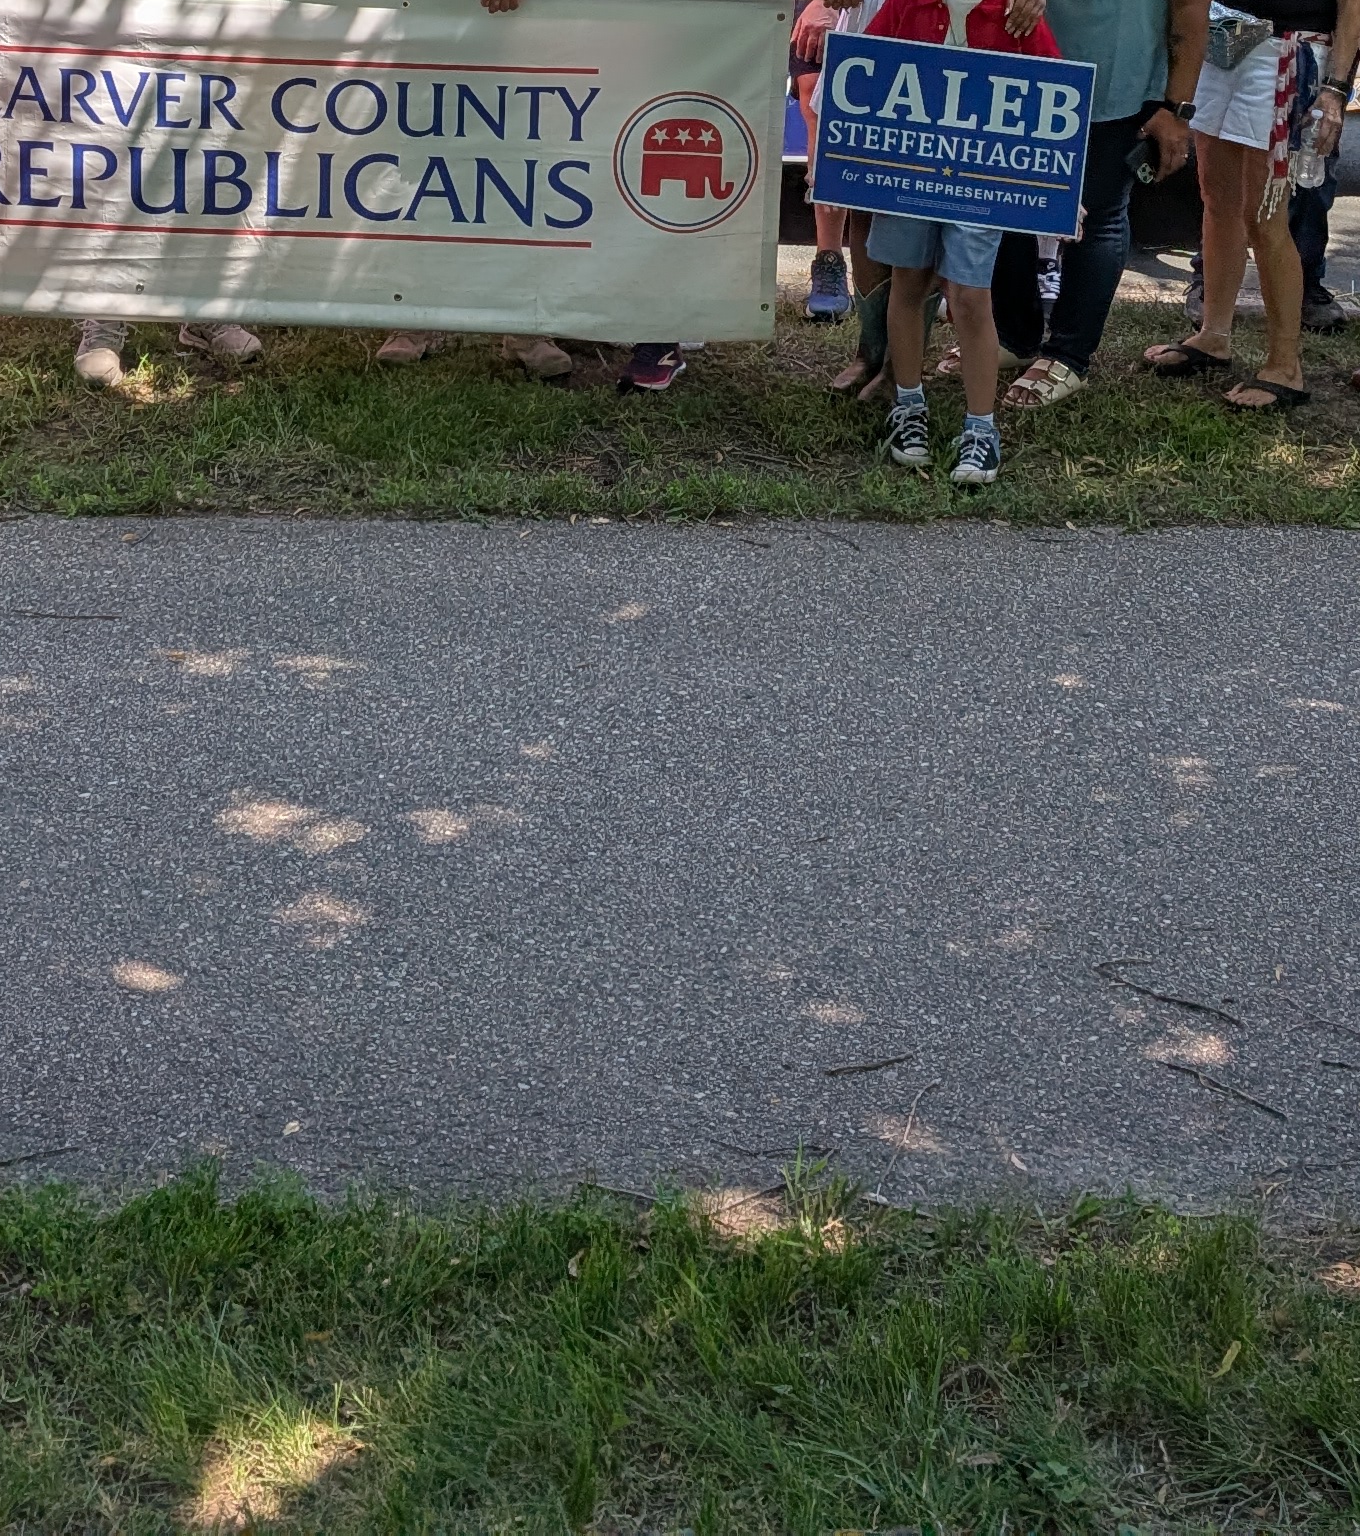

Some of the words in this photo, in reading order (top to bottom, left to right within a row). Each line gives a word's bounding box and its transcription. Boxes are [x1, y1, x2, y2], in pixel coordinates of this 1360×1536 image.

[270, 77, 602, 143] COUNTY
[831, 56, 1081, 141] CALEB
[827, 119, 1077, 175] STEFFENHAGEN
[841, 168, 860, 182] for
[865, 172, 910, 190] STATE
[915, 180, 1048, 208] REPRESENTATIVE
